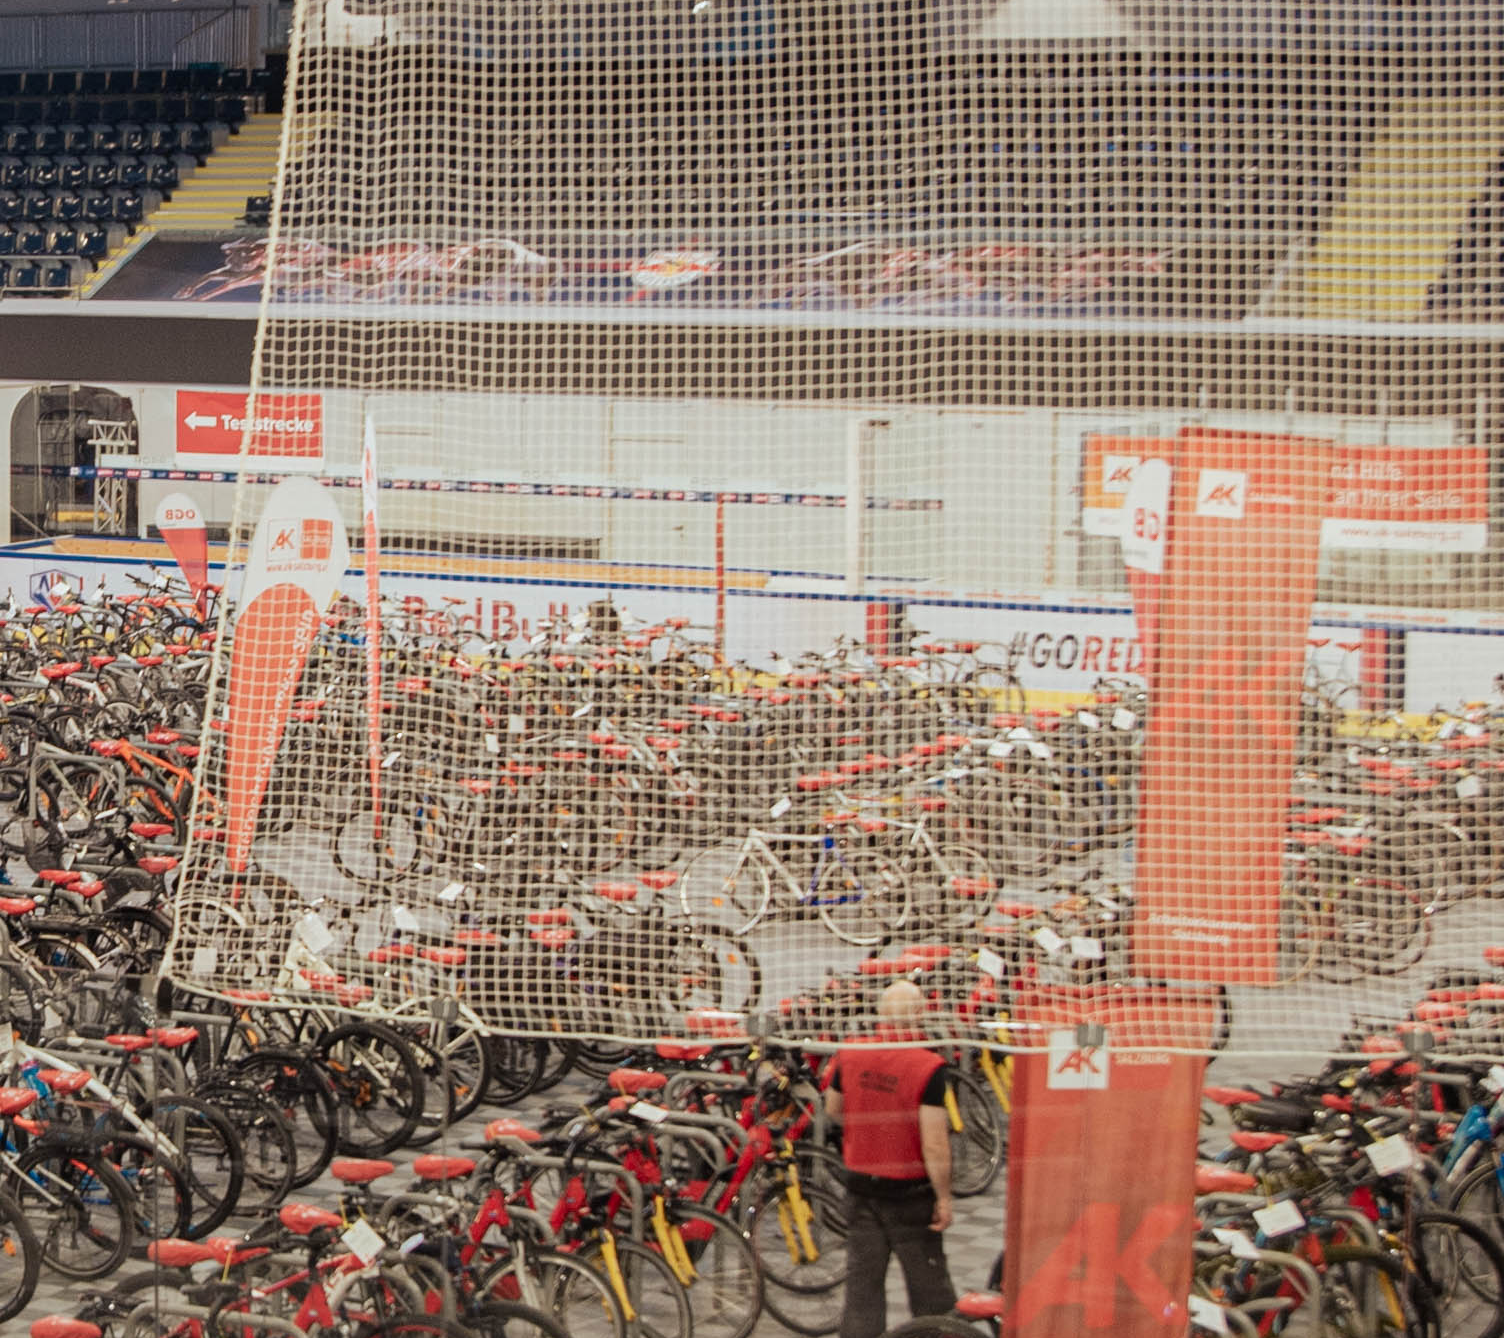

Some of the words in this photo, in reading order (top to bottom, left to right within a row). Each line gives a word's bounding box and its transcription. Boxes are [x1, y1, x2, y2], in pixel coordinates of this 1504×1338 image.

[1208, 484, 1238, 506] AK
[272, 528, 295, 550] AK
[1057, 1048, 1101, 1075] AK
[1017, 1201, 1189, 1329] AK
